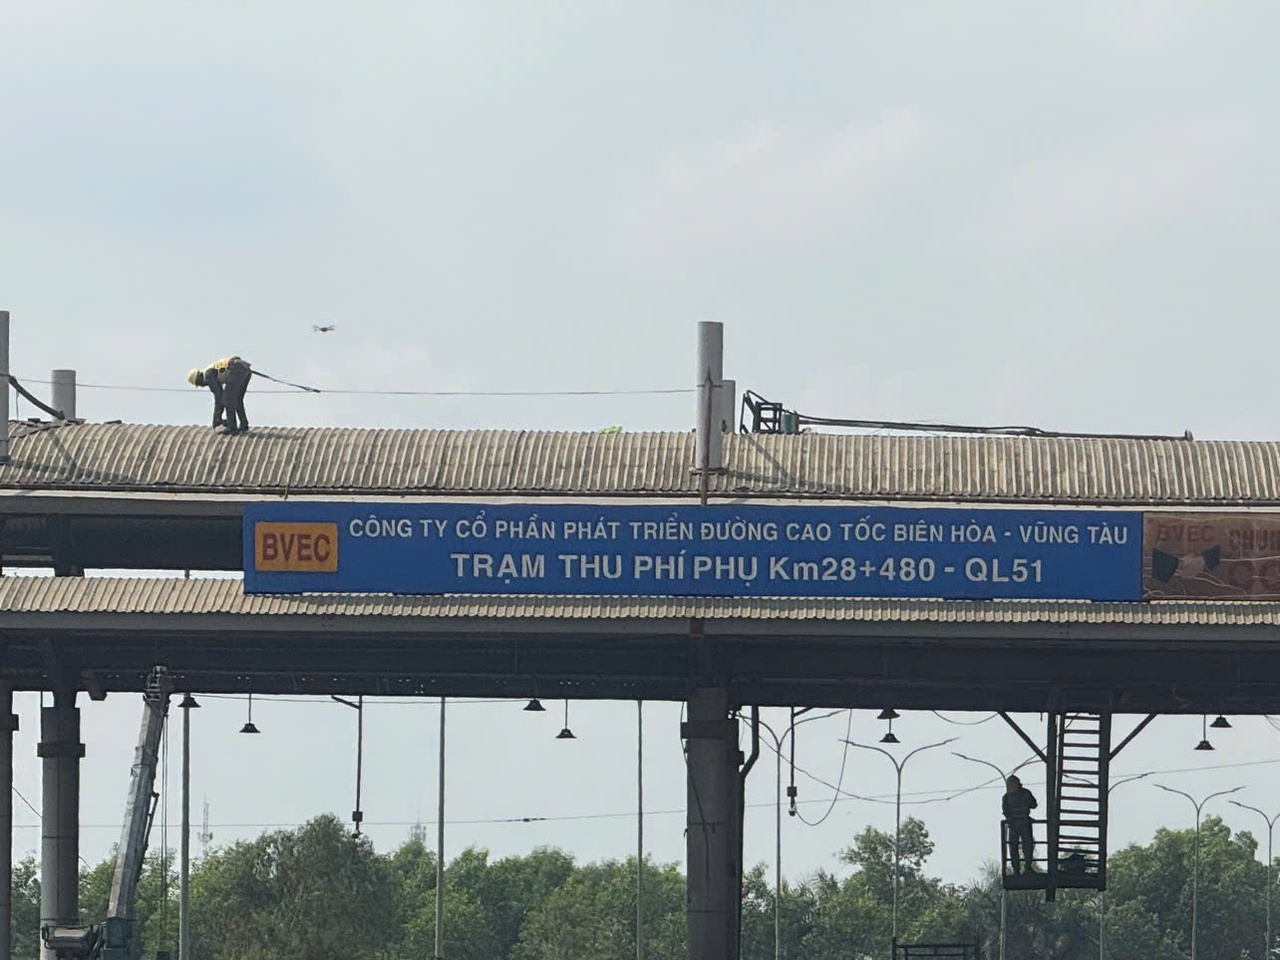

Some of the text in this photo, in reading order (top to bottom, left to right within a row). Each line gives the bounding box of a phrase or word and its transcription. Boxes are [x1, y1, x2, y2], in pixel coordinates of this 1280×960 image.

[349, 516, 413, 538] CÔNG
[420, 520, 448, 538] TY
[456, 509, 487, 538] CỔ
[495, 513, 556, 540] PHẦN
[563, 517, 620, 540] PHÁT
[629, 511, 694, 541] TRIỂN
[700, 517, 778, 542] ĐƯỜNG
[786, 522, 832, 542] CAO
[840, 515, 887, 542] TỐC
[894, 517, 944, 542] BIÊN
[951, 519, 997, 543] HÒA
[1019, 520, 1080, 544] VŨNG
[1087, 520, 1129, 545] TÀU
[1157, 524, 1214, 543] BVEC
[262, 533, 332, 562] BVEC
[451, 552, 545, 584] TRẠM
[558, 554, 623, 579] THU
[634, 548, 685, 580] PHÍ
[693, 555, 758, 587] PHỤ
[769, 556, 936, 582] Km28+480
[965, 558, 1044, 583] QL51
